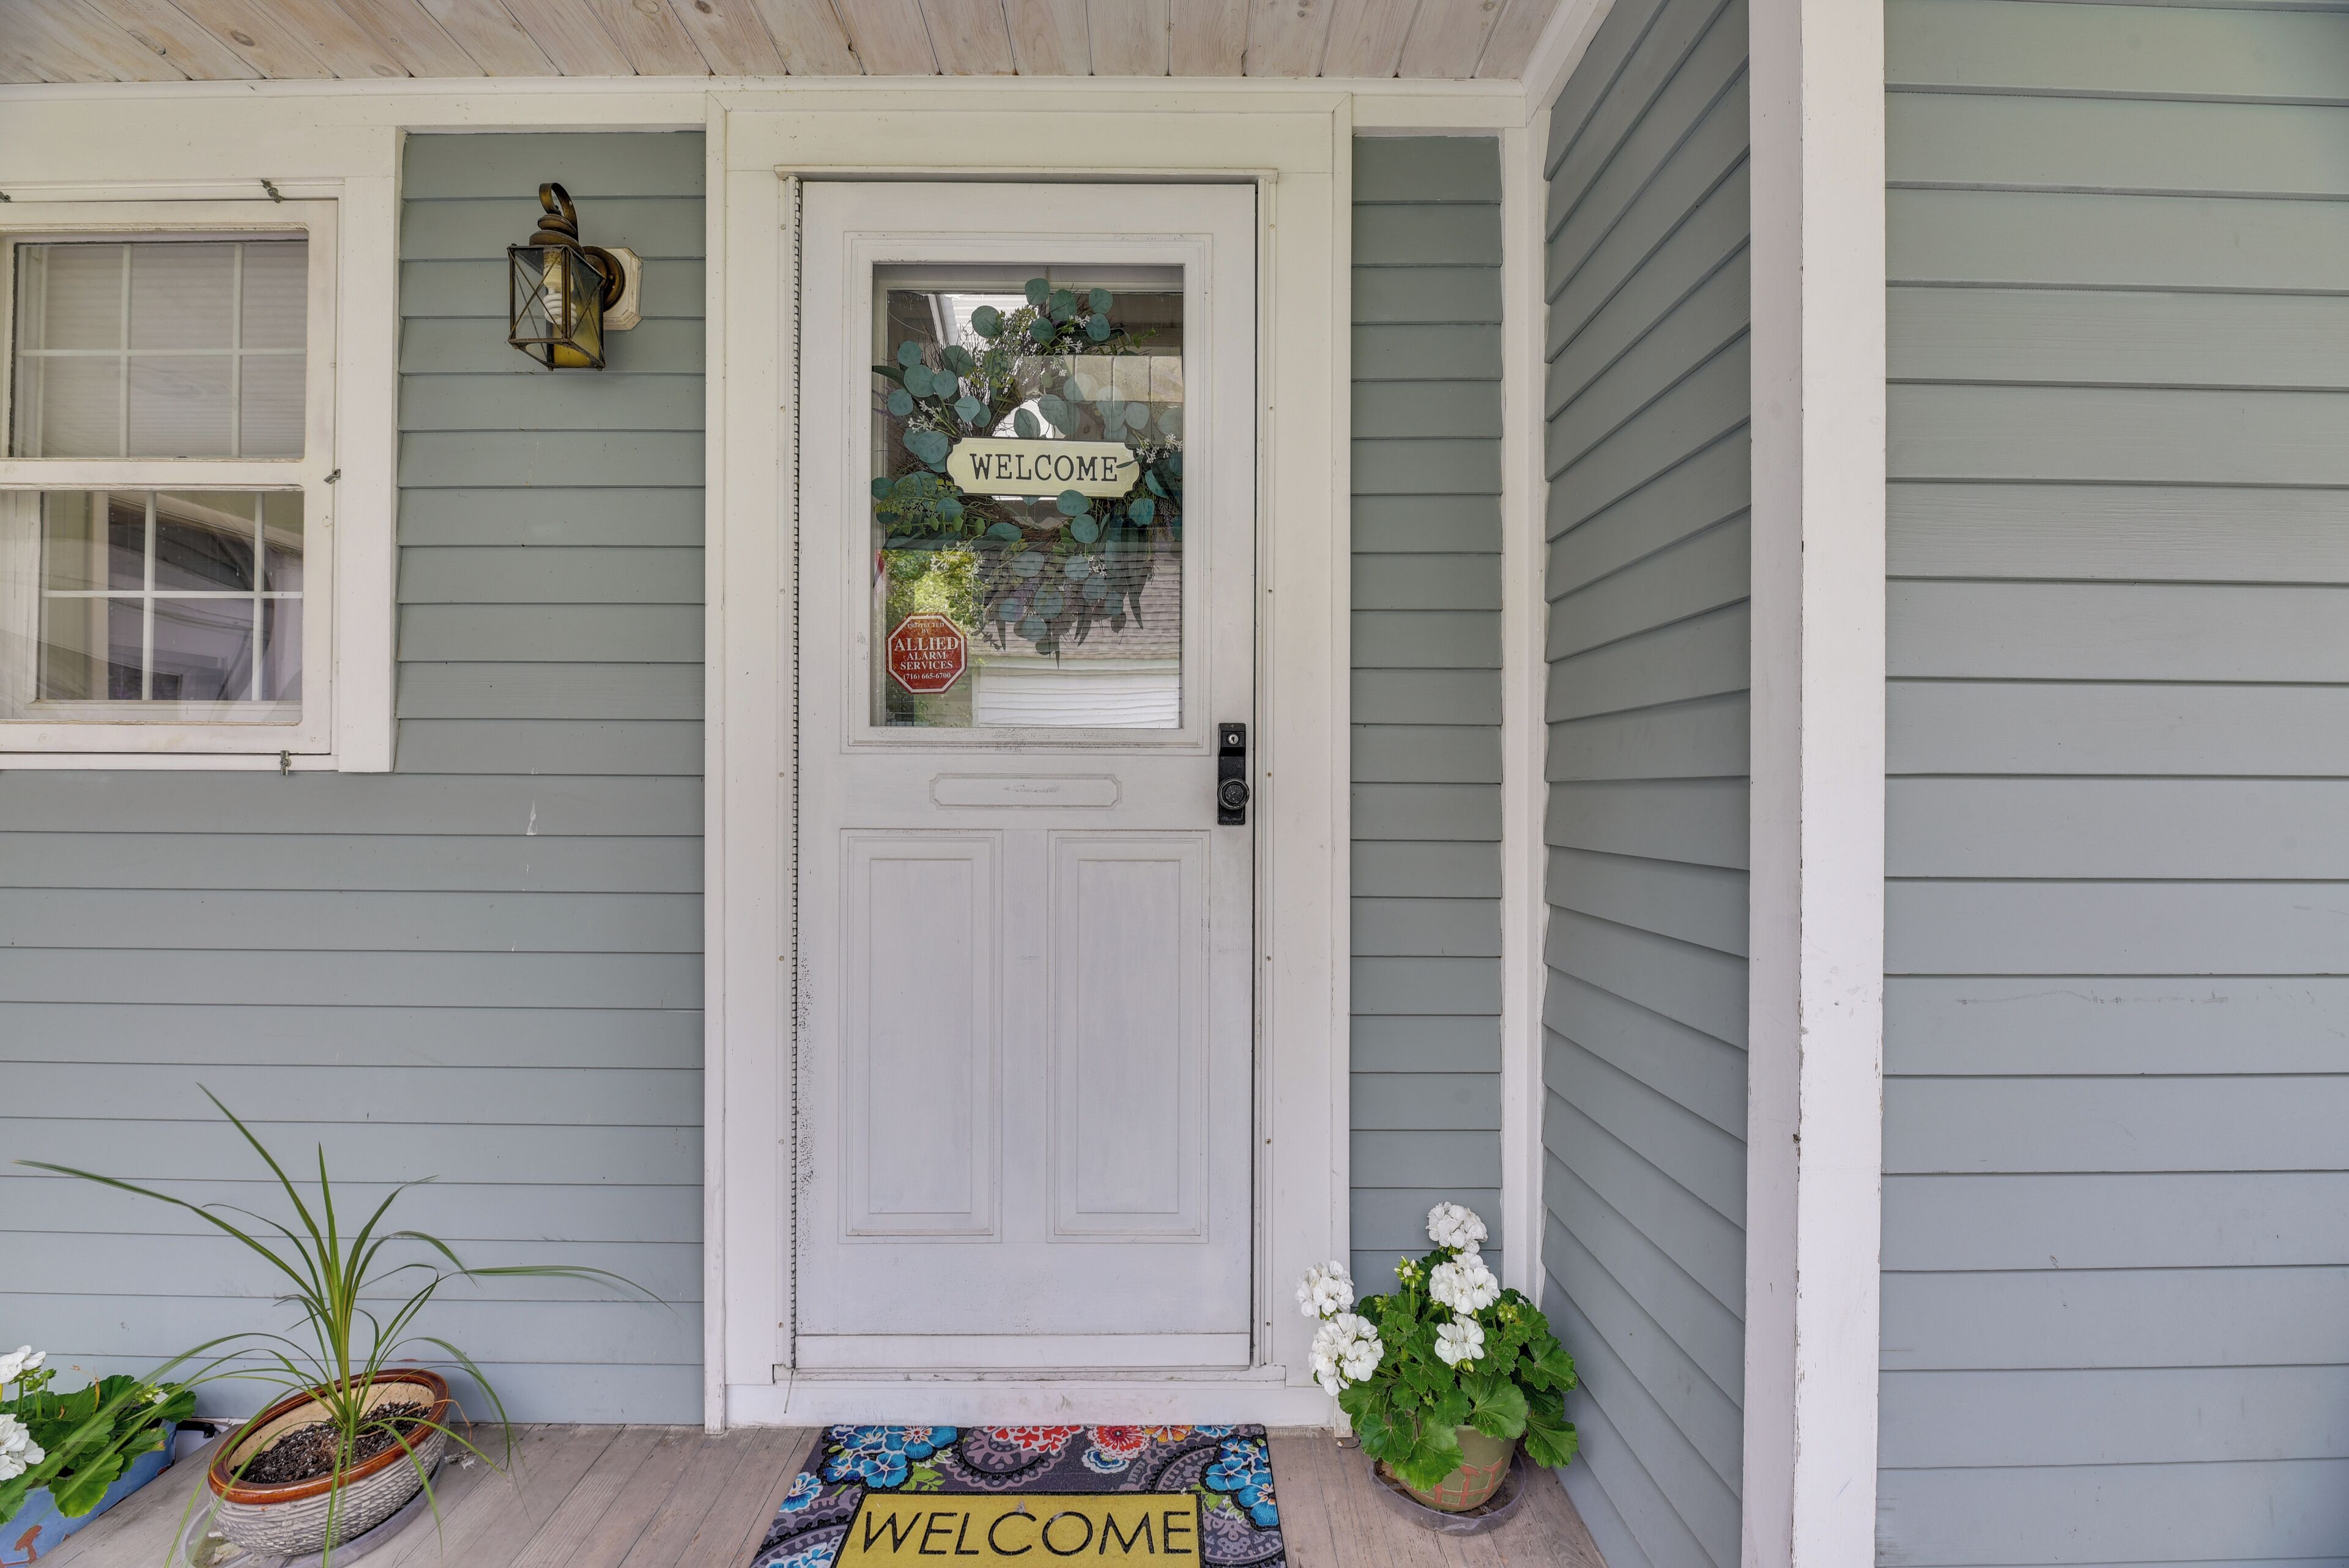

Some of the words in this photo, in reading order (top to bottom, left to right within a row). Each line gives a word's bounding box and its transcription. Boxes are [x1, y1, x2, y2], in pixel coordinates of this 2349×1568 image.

[969, 453, 1118, 481] WELCOME
[894, 636, 959, 652] ALLIED
[907, 651, 946, 661] ALARM
[900, 661, 954, 671] SERVICES
[863, 1510, 1192, 1556] WELCOME
